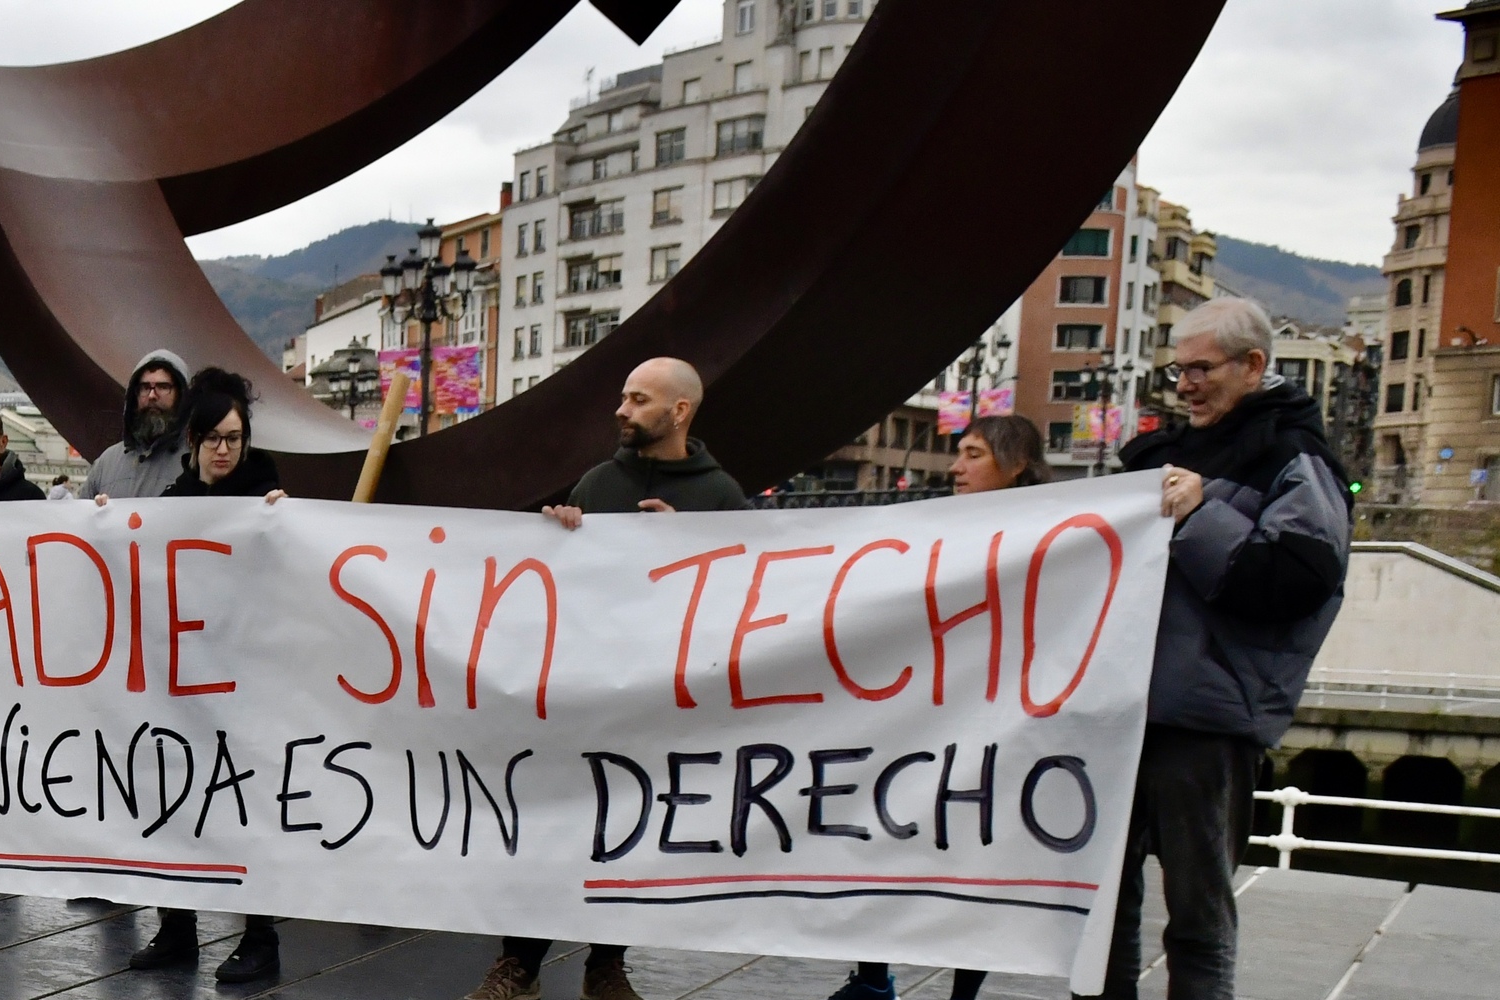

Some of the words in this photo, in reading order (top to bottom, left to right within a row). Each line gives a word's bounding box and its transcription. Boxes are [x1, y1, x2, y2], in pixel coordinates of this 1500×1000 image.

[648, 513, 1124, 718] TECHO
[276, 734, 375, 851] ES
[405, 748, 535, 858] UN
[580, 741, 1098, 862] DERECHO
